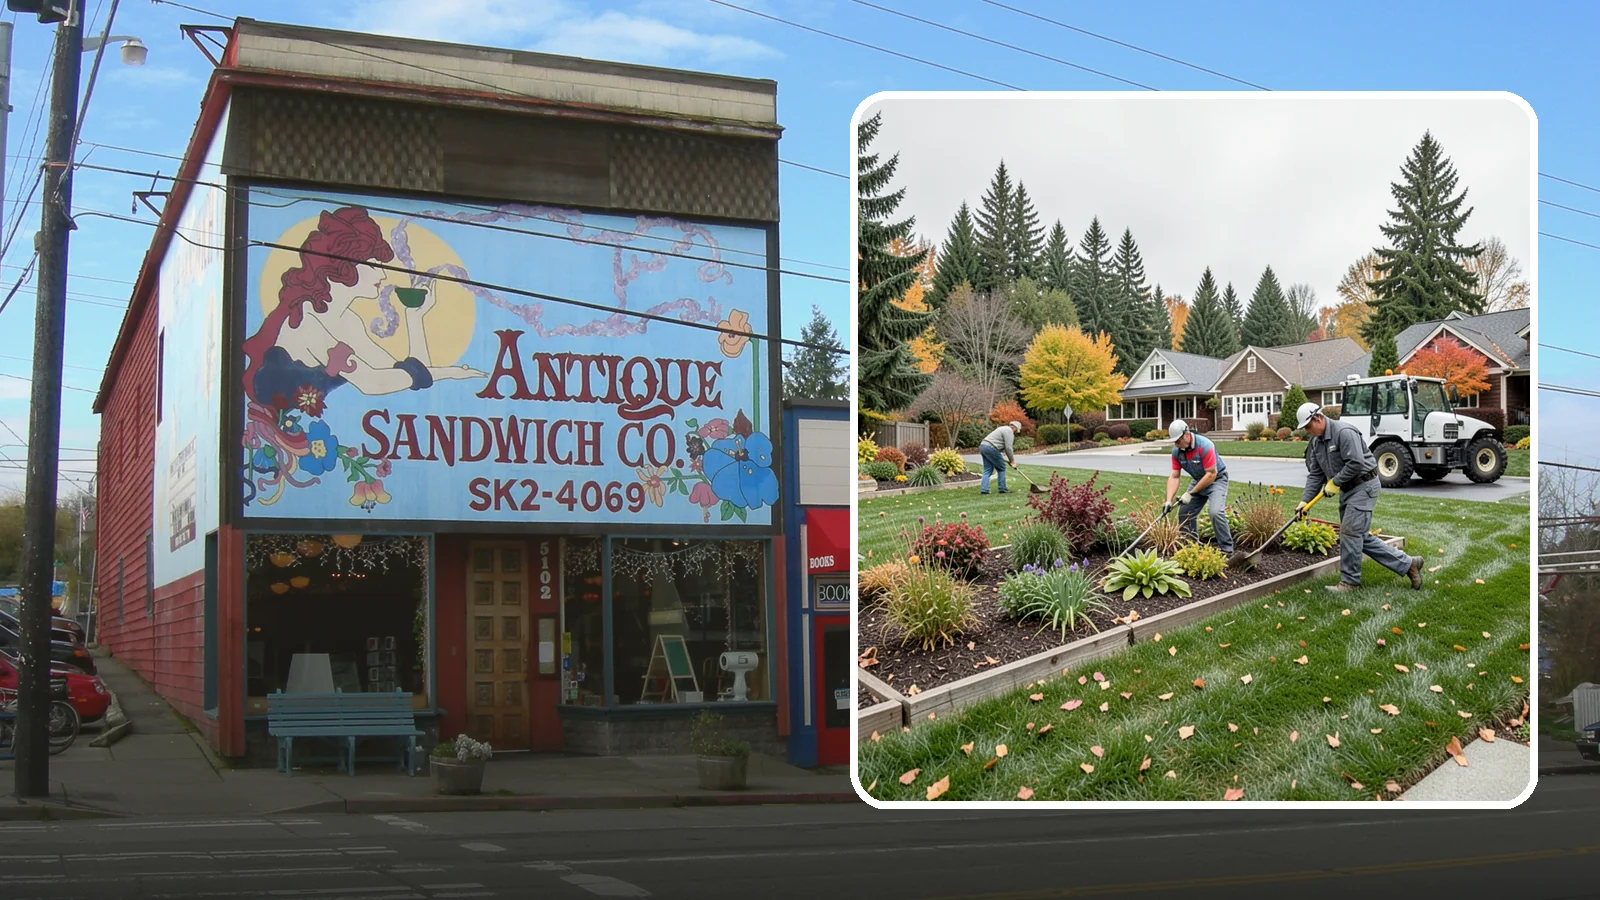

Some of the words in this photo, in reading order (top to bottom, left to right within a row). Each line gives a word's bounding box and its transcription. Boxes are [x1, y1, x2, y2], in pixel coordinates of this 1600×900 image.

[476, 328, 724, 421] ANTIQUE
[361, 408, 605, 468] SANDWICH
[616, 421, 686, 469] CO.
[468, 476, 646, 514] SK2-4069
[539, 541, 552, 600] 5102
[810, 555, 835, 569] BOOKS
